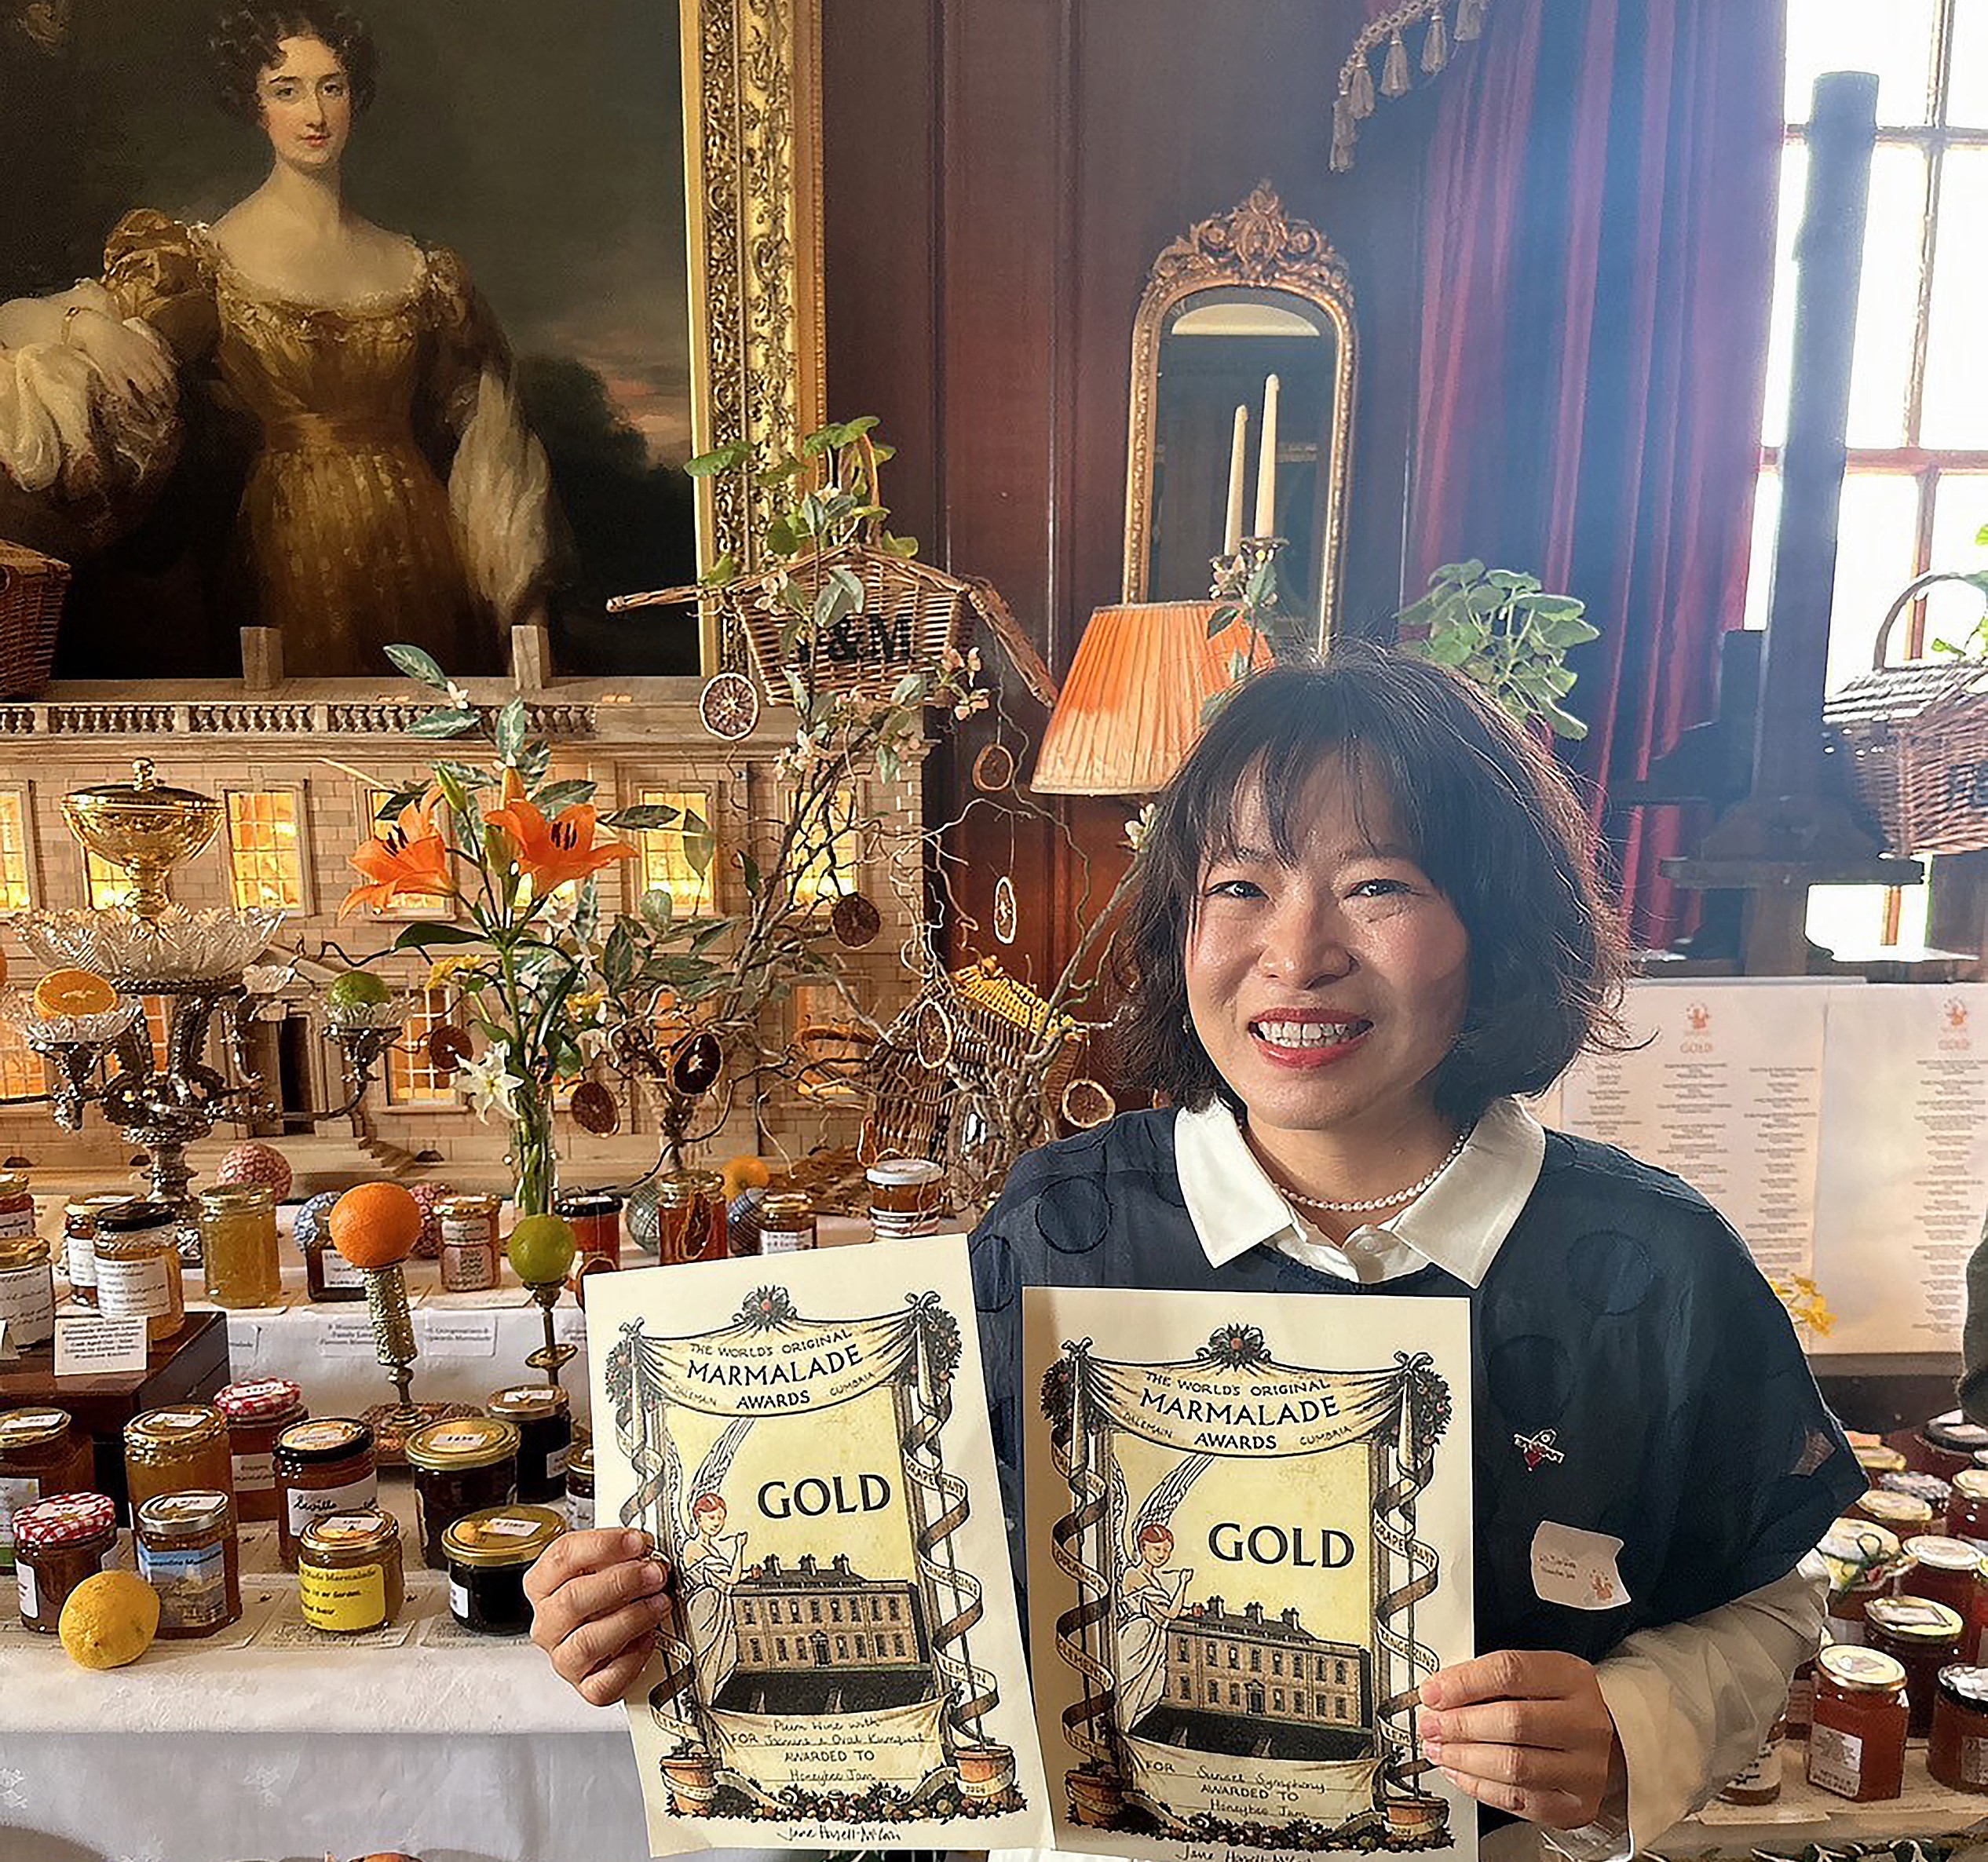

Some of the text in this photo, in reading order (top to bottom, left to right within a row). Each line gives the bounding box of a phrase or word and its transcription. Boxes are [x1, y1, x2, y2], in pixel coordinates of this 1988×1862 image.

[1679, 1042, 1713, 1053] GOLD
[689, 1328, 853, 1359] THE WORLD'S ORIGINAL
[687, 1343, 864, 1386] MARMALADE
[1145, 1371, 1331, 1396] THE WORLD'S ORIGINAL
[736, 1389, 811, 1409] AWARDS
[1139, 1388, 1341, 1426] MARMALADE
[1193, 1432, 1277, 1450] AWARDS
[1299, 1426, 1352, 1446] CUMBRIA
[758, 1473, 891, 1519] GOLD
[1208, 1522, 1355, 1568] GOLD
[731, 1732, 758, 1744] FOR
[784, 1749, 875, 1763] AWARDED TO
[1146, 1761, 1326, 1794] FOR Sunset Symphony
[1200, 1784, 1300, 1802] AWARDED TO
